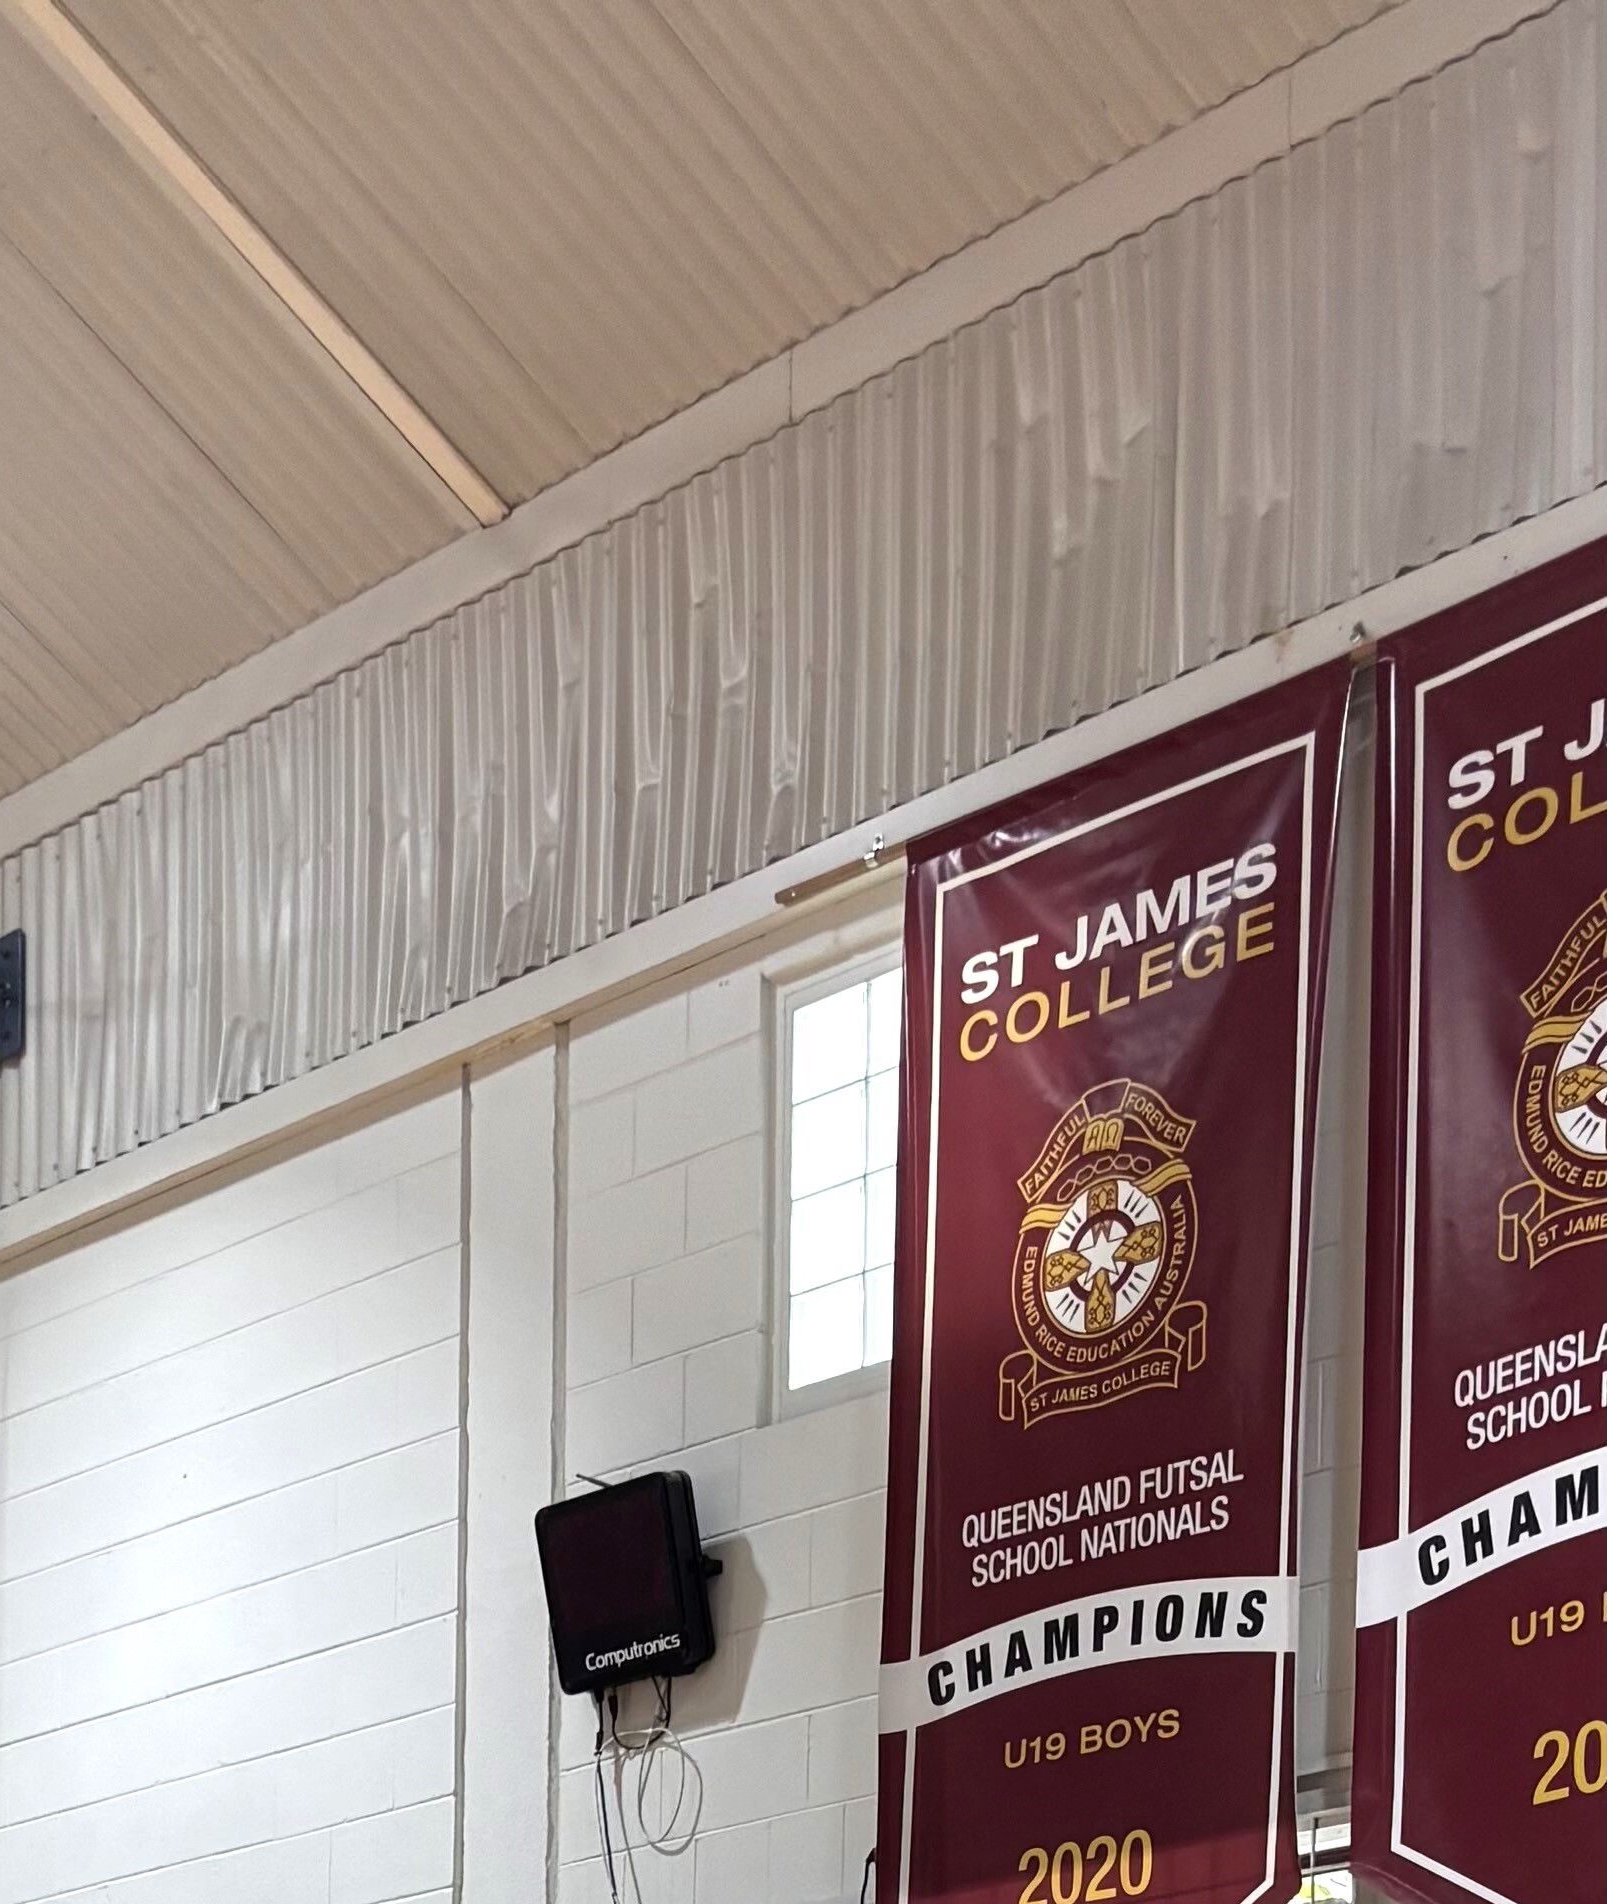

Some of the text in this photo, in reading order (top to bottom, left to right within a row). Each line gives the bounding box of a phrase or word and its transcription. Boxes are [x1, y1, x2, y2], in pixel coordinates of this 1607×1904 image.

[1448, 699, 1607, 810] ST J
[960, 842, 1278, 1005] ST JAMES
[1530, 914, 1606, 1010] FAITHFUL
[959, 901, 1275, 1063] COLLEGE
[1024, 1092, 1187, 1196] FAITHFUL FOREVER
[1525, 1064, 1549, 1154] EDMUND
[1542, 1150, 1582, 1187] RICE
[1021, 1194, 1187, 1364] EDMUND RICE EDUCATION AUSTRALIA
[1537, 1222, 1559, 1249] ST
[1030, 1360, 1171, 1412] ST JAMES COLLEGE
[1466, 1379, 1591, 1451] SCHOOL
[961, 1449, 1244, 1548] QUEENSLAND FUTSAL
[971, 1495, 1230, 1588] SCHOOL NATIONALS
[1416, 1464, 1600, 1587] CHAM
[585, 1633, 681, 1671] Computronics
[927, 1588, 1268, 1707] CHAMPIONS
[1510, 1598, 1585, 1646] U19
[1003, 1708, 1181, 1769] U19 BOYS
[1532, 1718, 1607, 1805] 20
